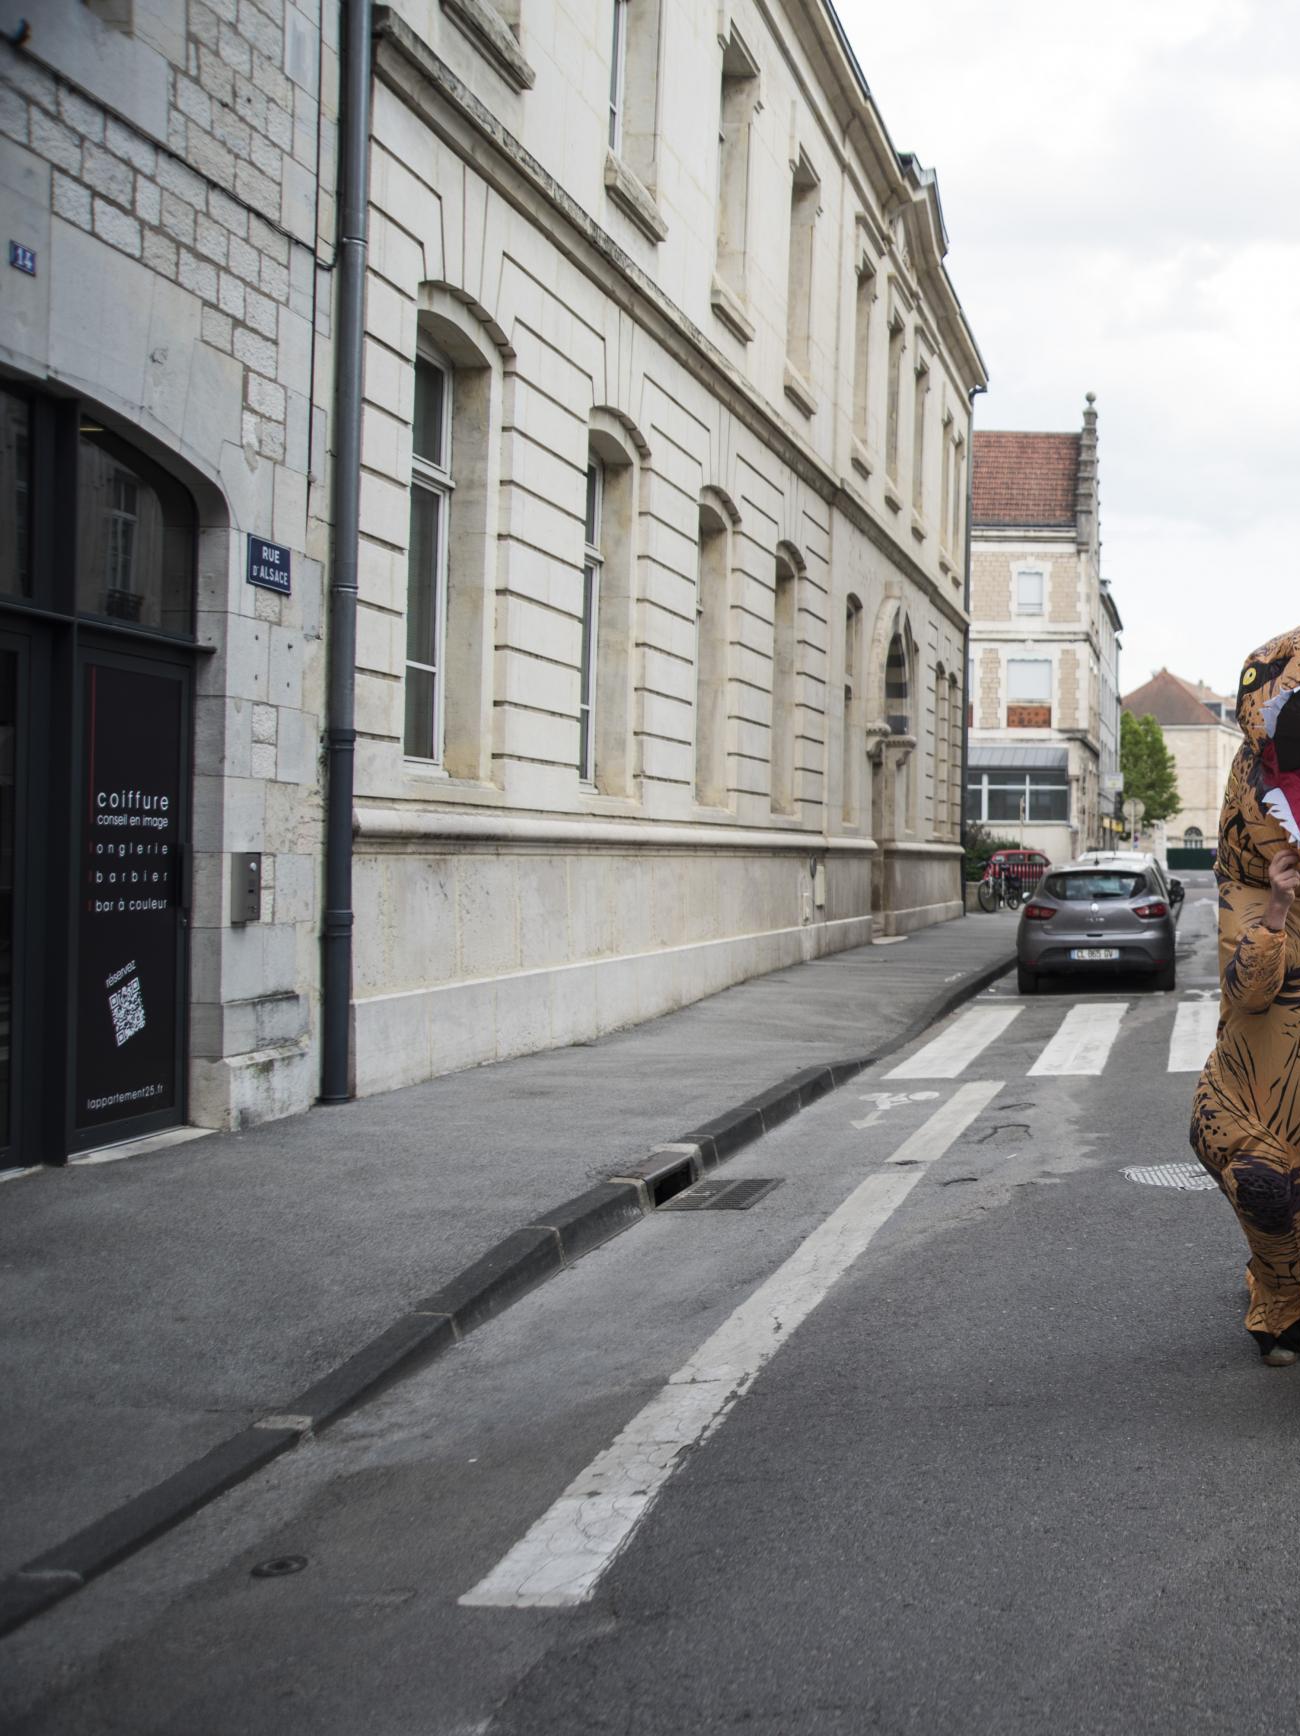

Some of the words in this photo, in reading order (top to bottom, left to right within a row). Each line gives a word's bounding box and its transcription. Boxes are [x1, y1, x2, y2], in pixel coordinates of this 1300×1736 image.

[17, 247, 33, 269] 14
[262, 546, 280, 564] RUE
[252, 565, 289, 586] D'ALSACE
[97, 790, 169, 811] coiffure
[97, 814, 128, 826] conseil
[129, 815, 141, 826] en
[142, 815, 169, 830] image
[96, 842, 168, 857] onglerie
[96, 869, 168, 883] barbier
[95, 899, 115, 912] bar
[118, 898, 125, 911] à
[128, 897, 167, 911] couleur
[105, 959, 136, 989] réservez
[87, 1083, 164, 1111] lappartement25.fr
